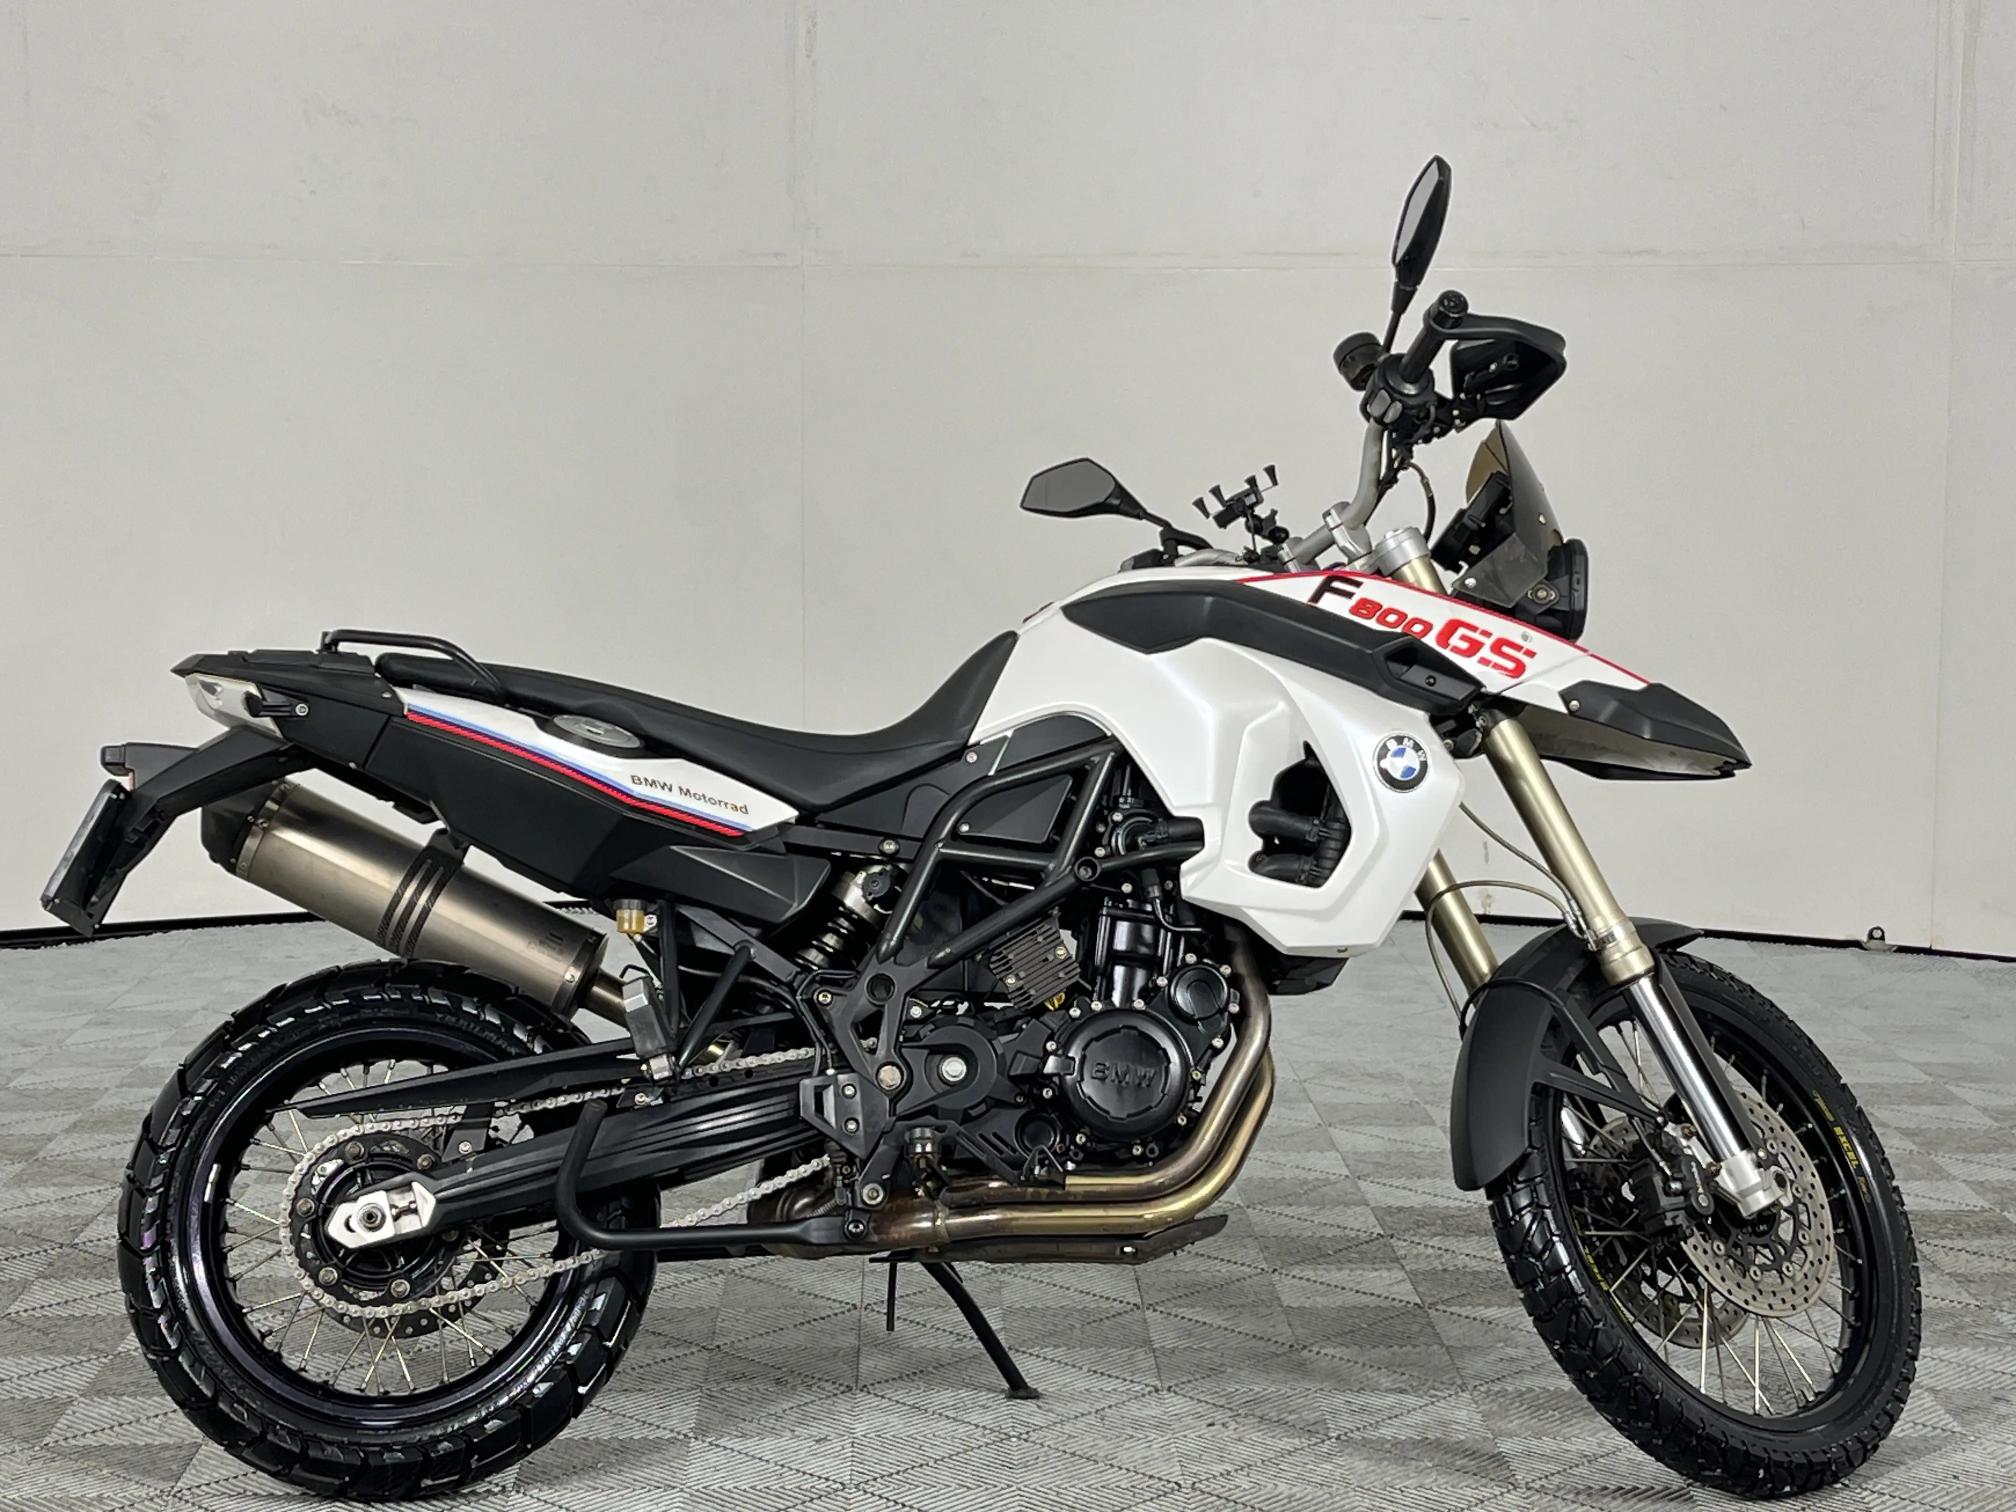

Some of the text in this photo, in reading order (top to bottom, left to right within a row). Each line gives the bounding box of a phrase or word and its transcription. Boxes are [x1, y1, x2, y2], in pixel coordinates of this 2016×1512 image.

[630, 774, 749, 815] BMW Motorrad
[1091, 1062, 1157, 1088] BMW
